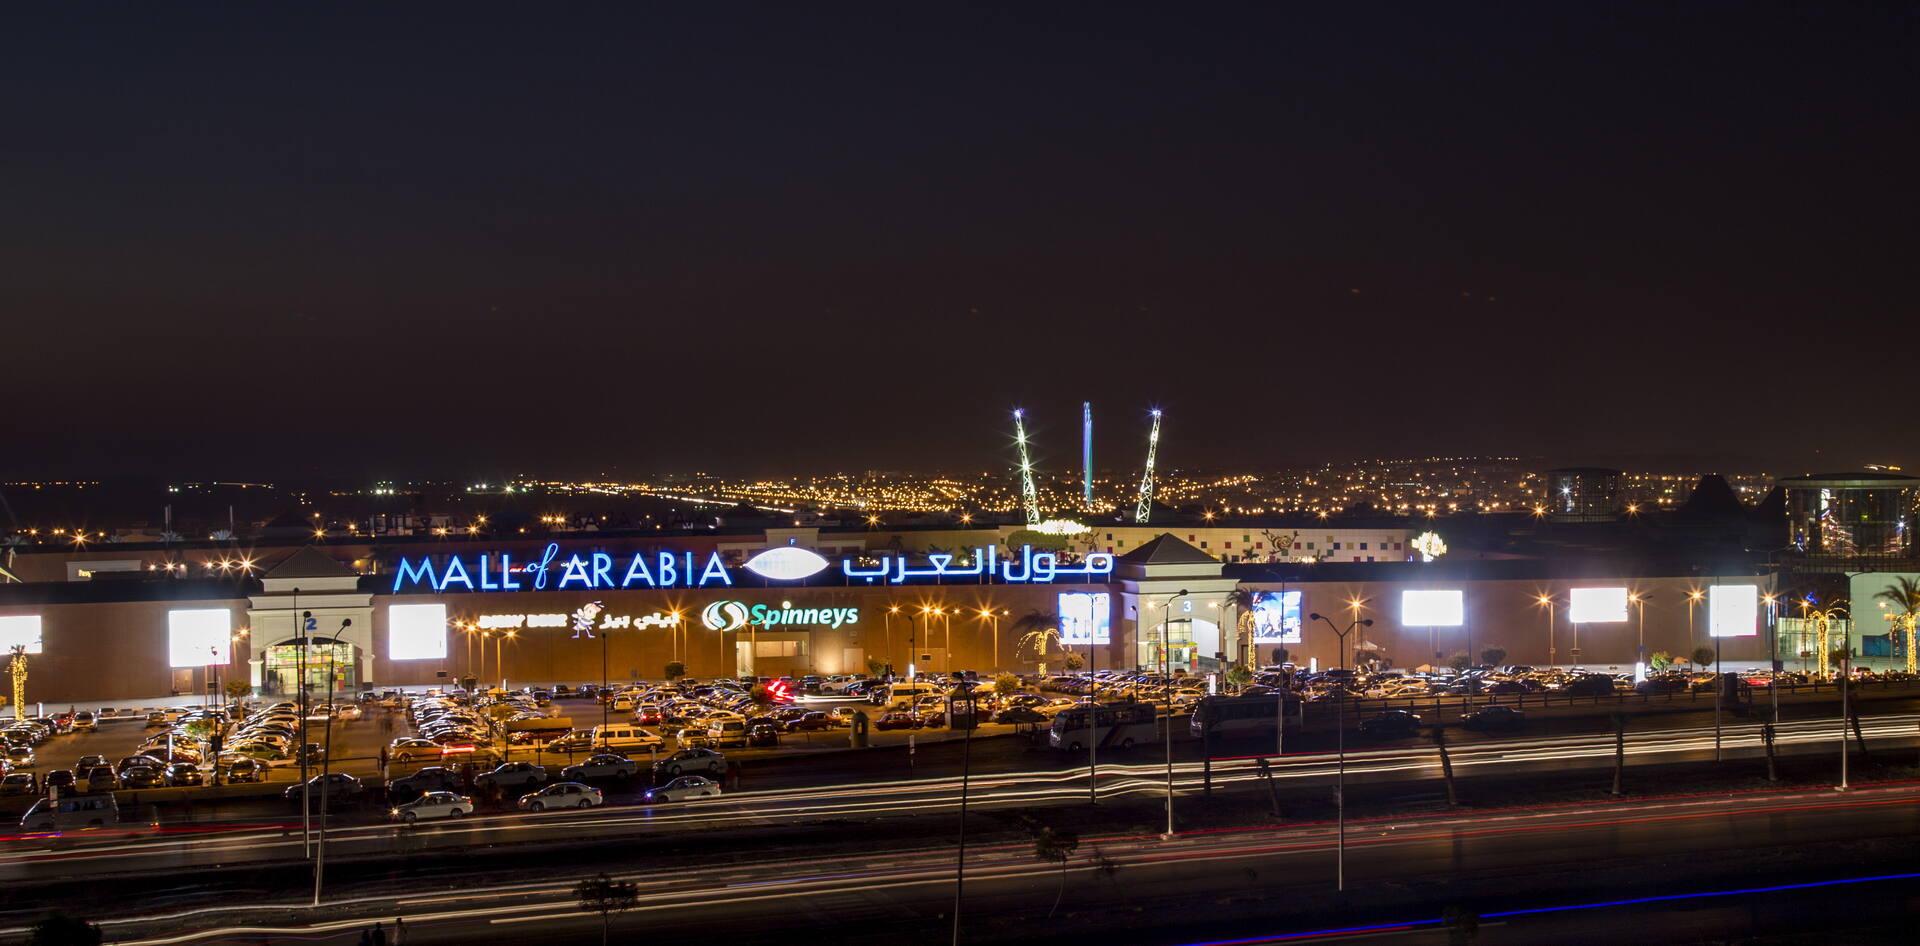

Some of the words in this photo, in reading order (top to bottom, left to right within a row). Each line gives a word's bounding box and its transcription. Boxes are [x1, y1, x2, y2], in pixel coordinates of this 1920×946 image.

[393, 553, 521, 592] MALL
[525, 542, 559, 590] of
[558, 550, 733, 589] ARABIA
[842, 543, 997, 584] العرب
[1002, 543, 1114, 583] مول
[749, 600, 860, 631] Spinneys
[1183, 599, 1192, 612] 3
[305, 617, 318, 631] 2
